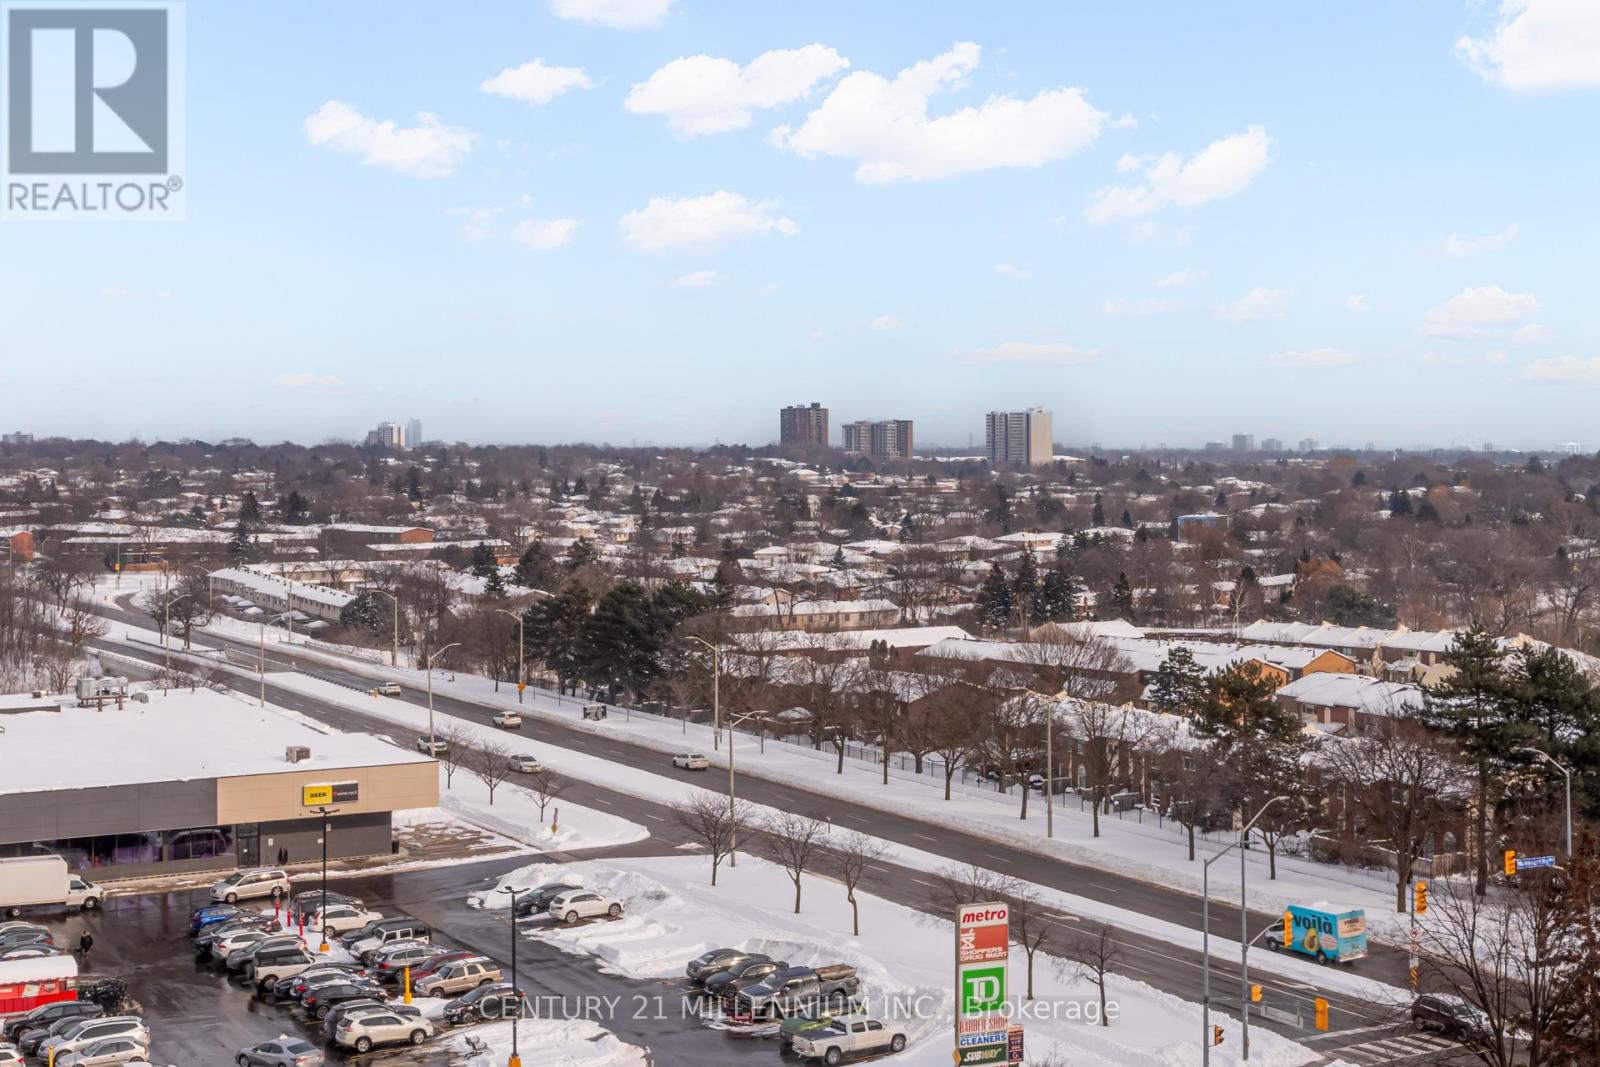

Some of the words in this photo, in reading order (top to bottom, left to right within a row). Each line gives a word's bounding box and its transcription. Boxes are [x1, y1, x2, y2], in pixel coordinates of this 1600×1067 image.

[962, 909, 1006, 923] metro
[1292, 914, 1332, 934] voilà
[960, 947, 1003, 956] SHOPPERS
[960, 953, 984, 961] DRUG
[985, 951, 1007, 959] MART
[966, 976, 999, 1003] TD
[960, 1018, 986, 1033] BARBER
[989, 1015, 1008, 1031] SHOP
[960, 1034, 1006, 1046] CLEANERS
[964, 1048, 1002, 1062] SUBWAY
